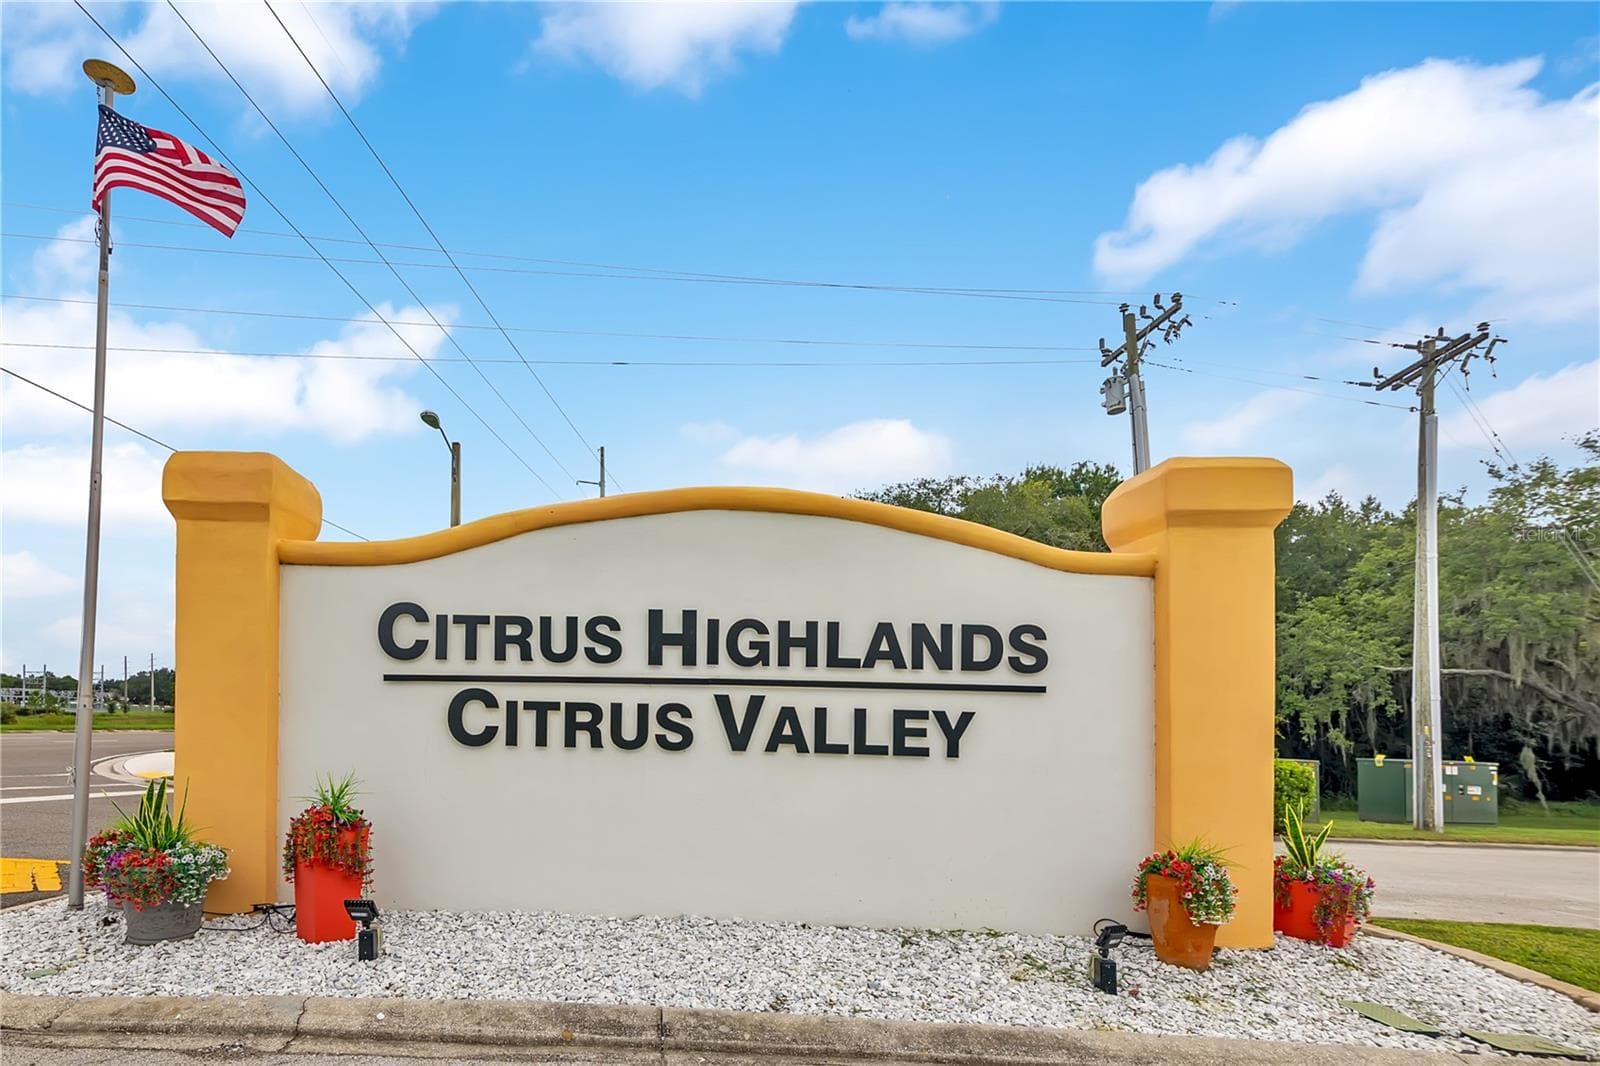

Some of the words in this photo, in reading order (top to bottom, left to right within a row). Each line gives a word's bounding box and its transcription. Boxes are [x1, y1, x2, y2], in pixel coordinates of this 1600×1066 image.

[377, 601, 623, 665] CITRUS
[647, 608, 1049, 675] HIGHLANDS
[447, 687, 694, 752] CITRUS
[713, 694, 976, 759] VALLEY
